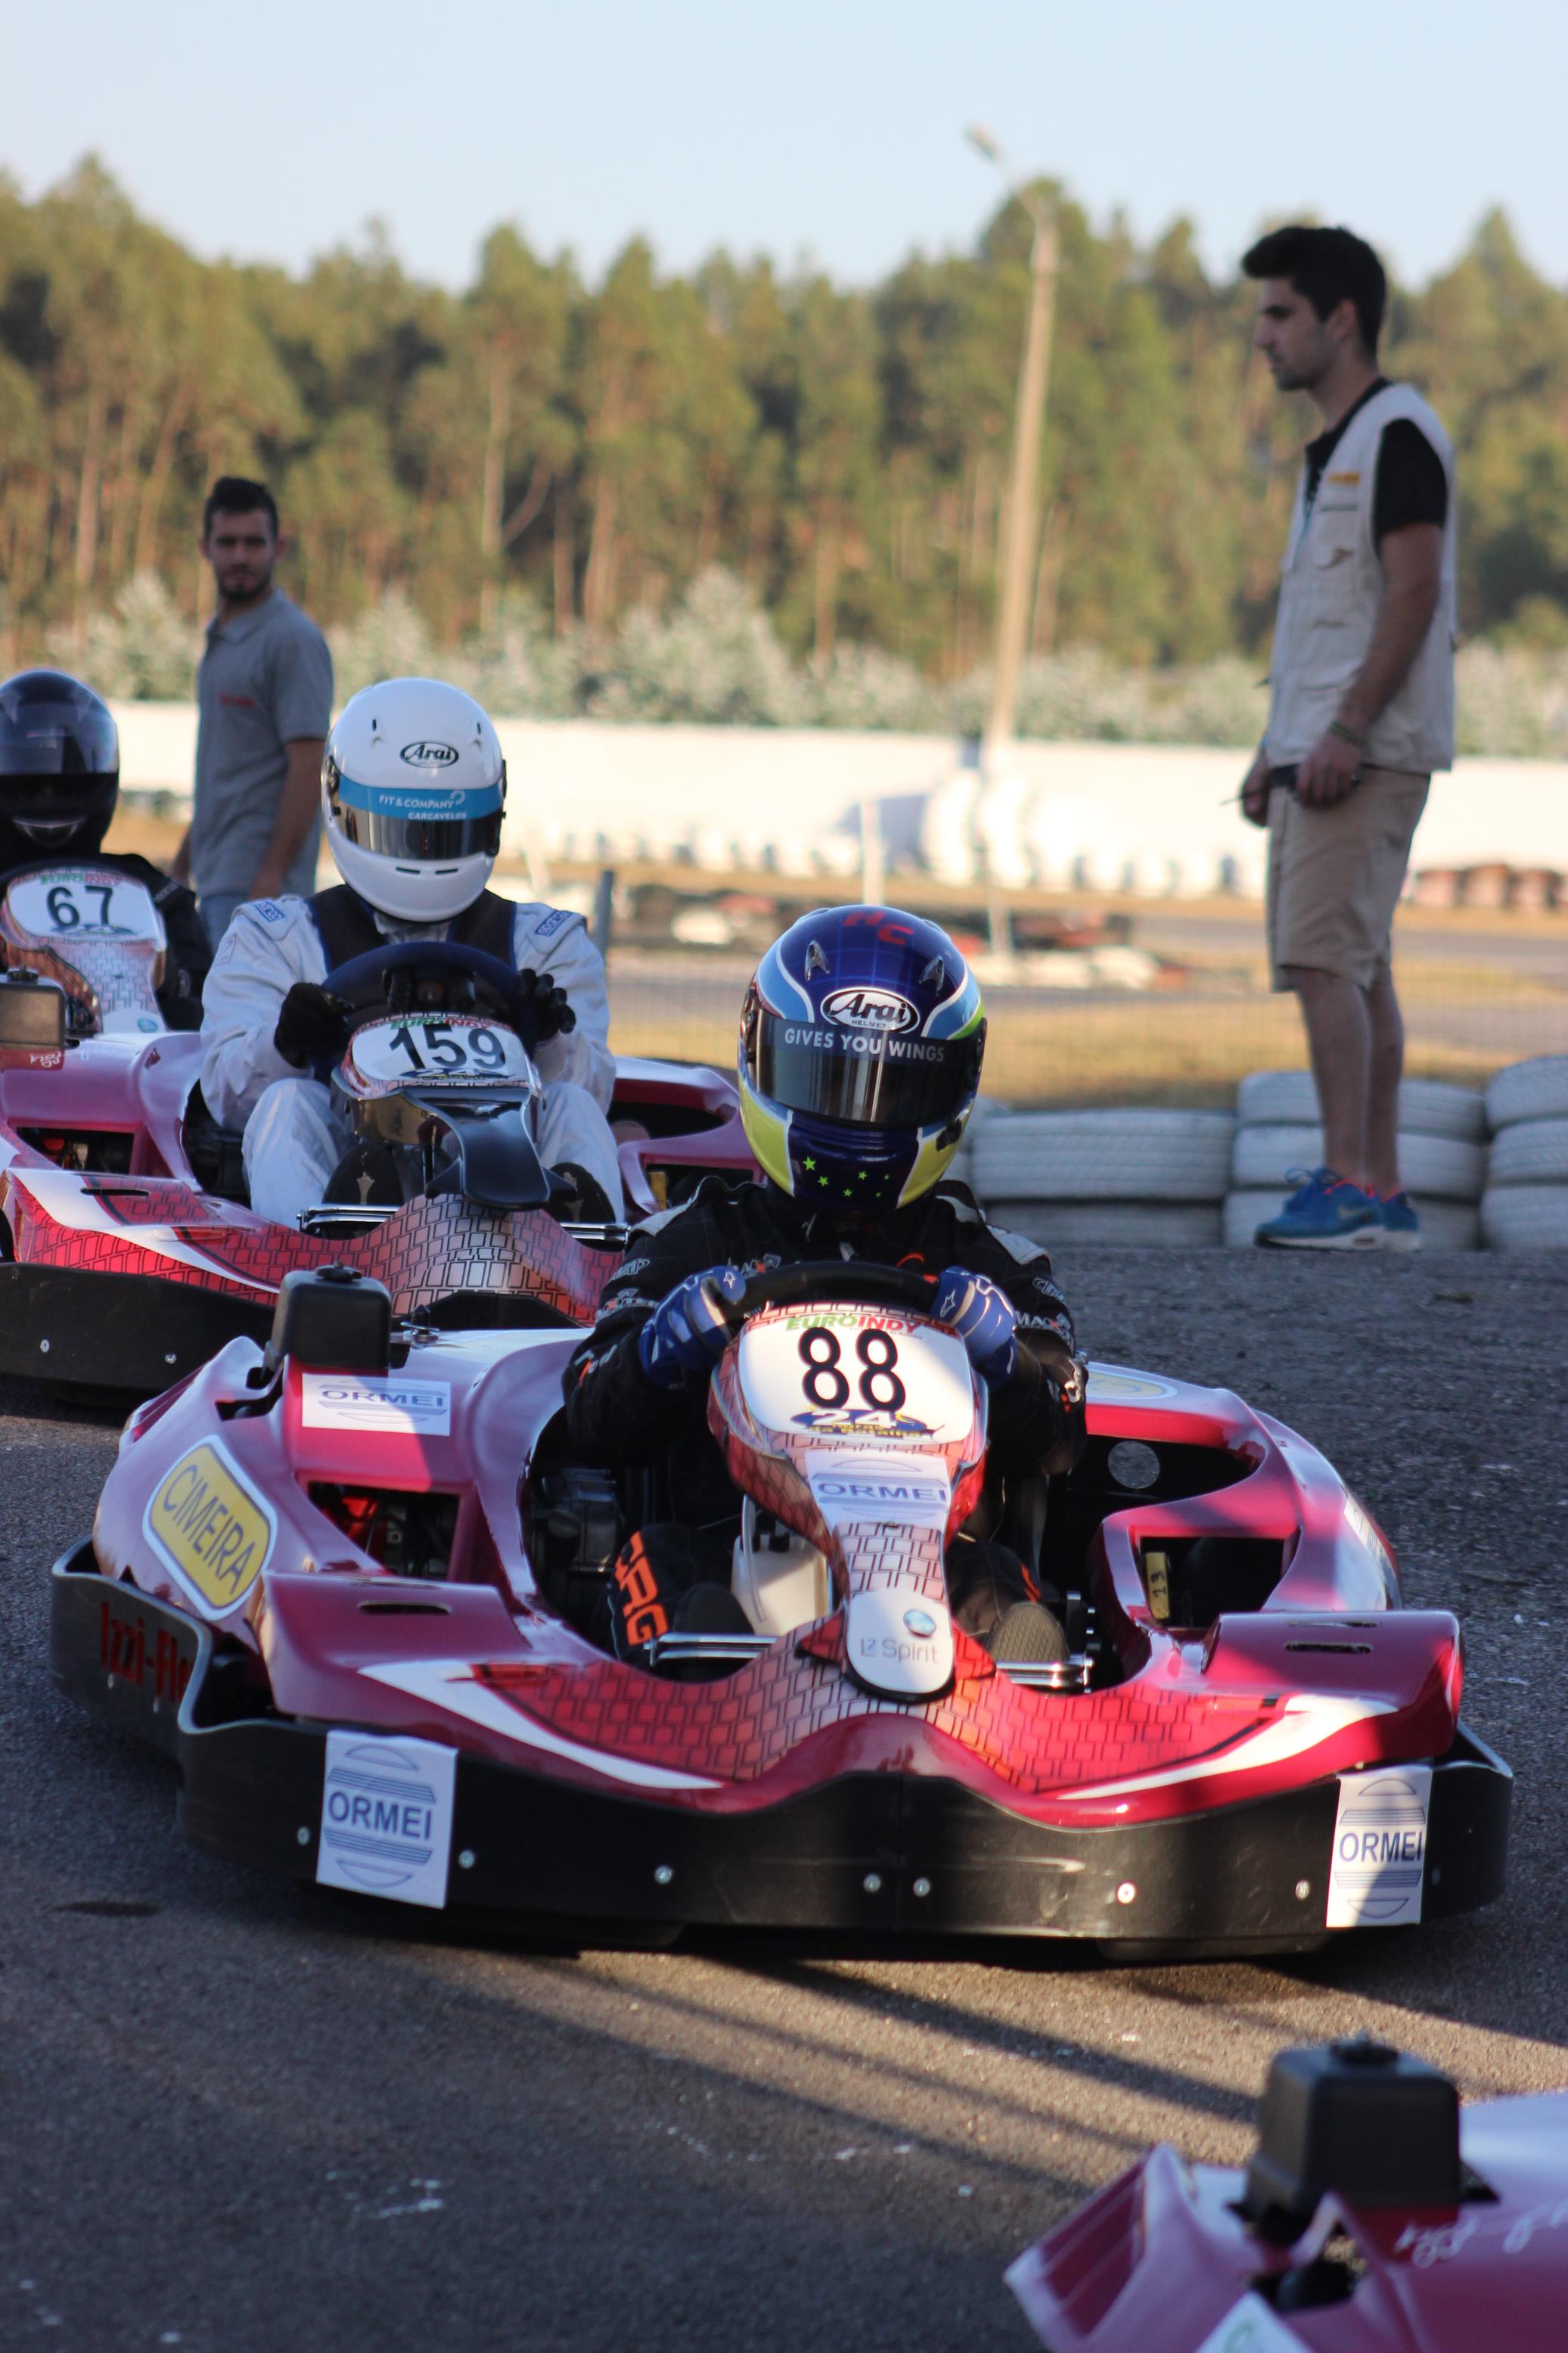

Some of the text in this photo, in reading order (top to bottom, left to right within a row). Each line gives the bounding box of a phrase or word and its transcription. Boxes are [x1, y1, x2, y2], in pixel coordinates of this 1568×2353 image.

[406, 744, 452, 761] Arai
[379, 795, 454, 809] FIT & COMPANY
[408, 812, 467, 821] CARCAVELOS
[47, 885, 113, 927] 67
[828, 993, 908, 1021] Arai
[852, 1019, 886, 1028] HELMET
[389, 1024, 506, 1071] 159
[784, 1027, 945, 1062] GIVES YOU WINGS
[798, 1327, 906, 1413] 88
[321, 1390, 444, 1407] ORMEI
[817, 1483, 946, 1501] ORMEI
[163, 1464, 256, 1596] CIMEIRA
[882, 1637, 939, 1665] Spirit
[328, 1791, 432, 1841] ORMEI
[1339, 1831, 1424, 1863] ORMEI
